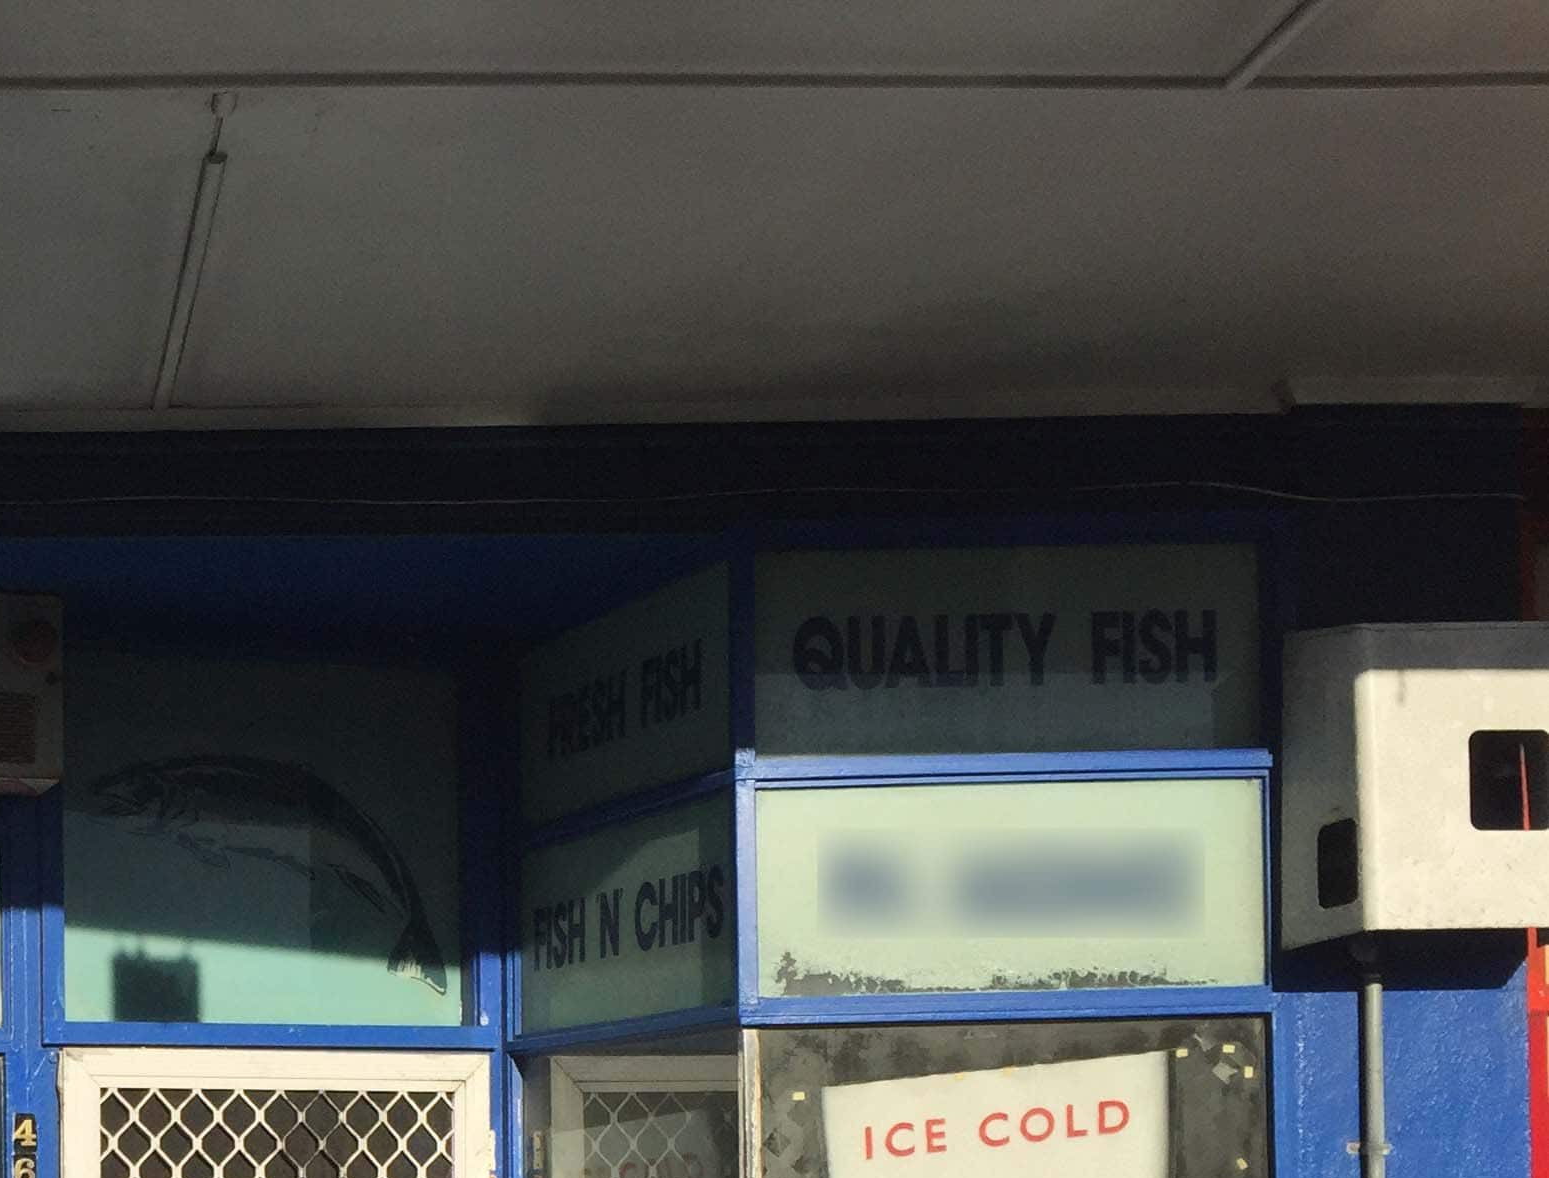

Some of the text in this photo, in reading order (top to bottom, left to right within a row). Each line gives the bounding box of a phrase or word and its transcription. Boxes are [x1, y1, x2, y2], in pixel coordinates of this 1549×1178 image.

[791, 608, 1218, 689] QUALITY FISH
[546, 638, 703, 759] FRESH FISH
[532, 895, 586, 971] FISH
[634, 863, 725, 953] CHIPS
[864, 1099, 1131, 1161] ICE COLD
